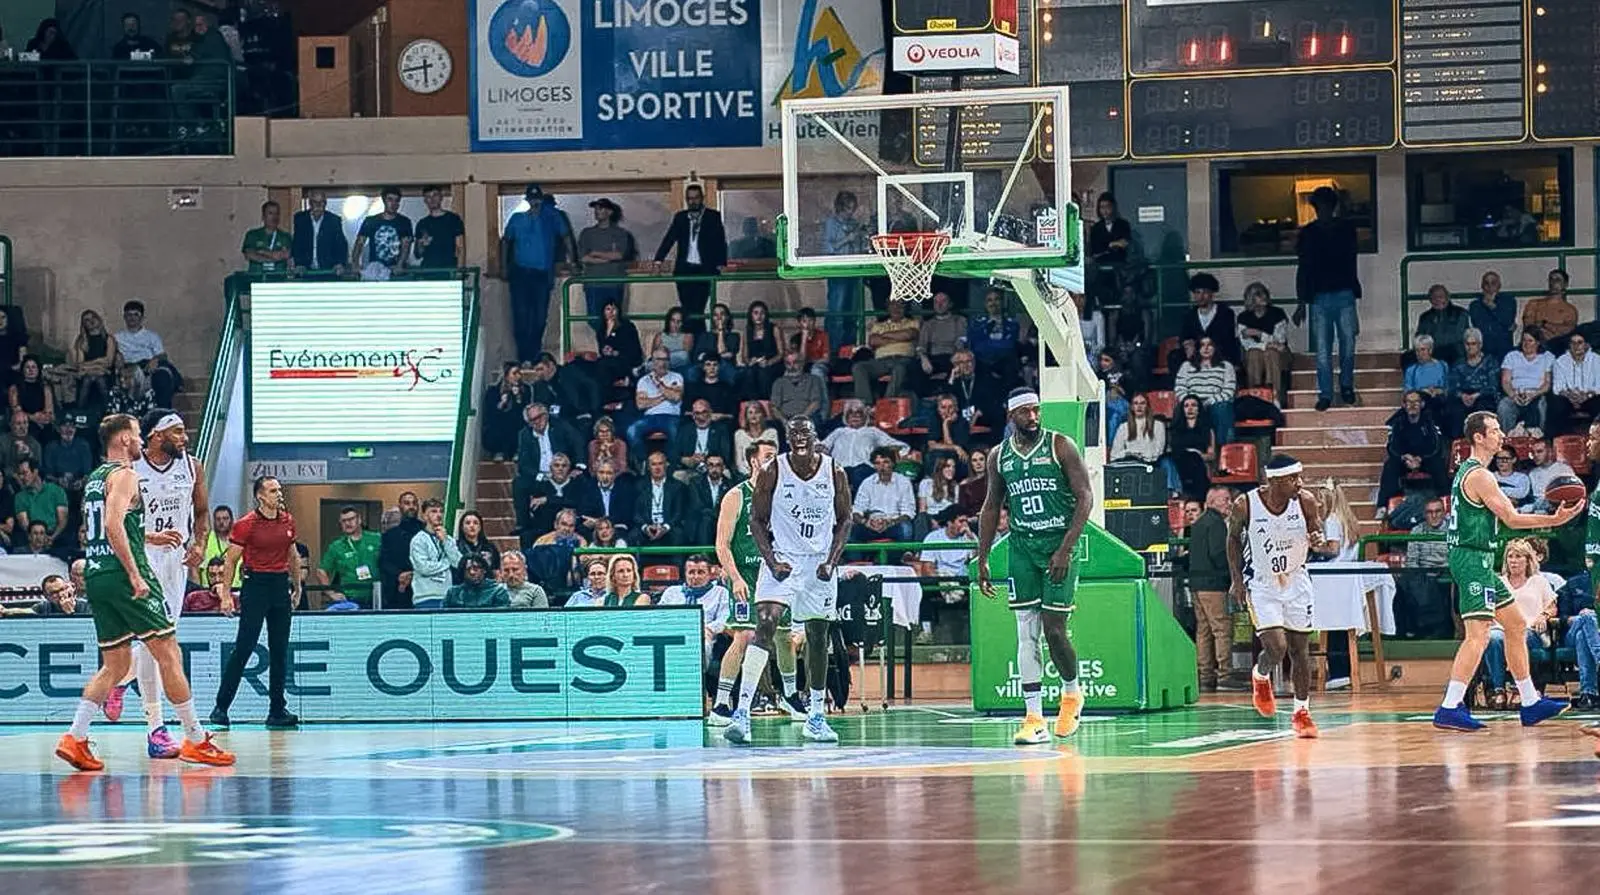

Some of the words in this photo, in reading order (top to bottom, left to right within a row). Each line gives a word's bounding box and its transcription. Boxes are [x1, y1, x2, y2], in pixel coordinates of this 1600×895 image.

[594, 0, 748, 29] LIMOGES
[628, 49, 714, 79] VILLE
[927, 47, 981, 59] VEOLIA
[487, 86, 573, 104] LIMOGES
[597, 90, 755, 121] SPORTIVE
[1007, 478, 1058, 497] LIMOGES
[1020, 494, 1045, 516] 20
[799, 521, 815, 539] 10
[0, 641, 332, 699] CETRE
[365, 634, 686, 696] OUEST
